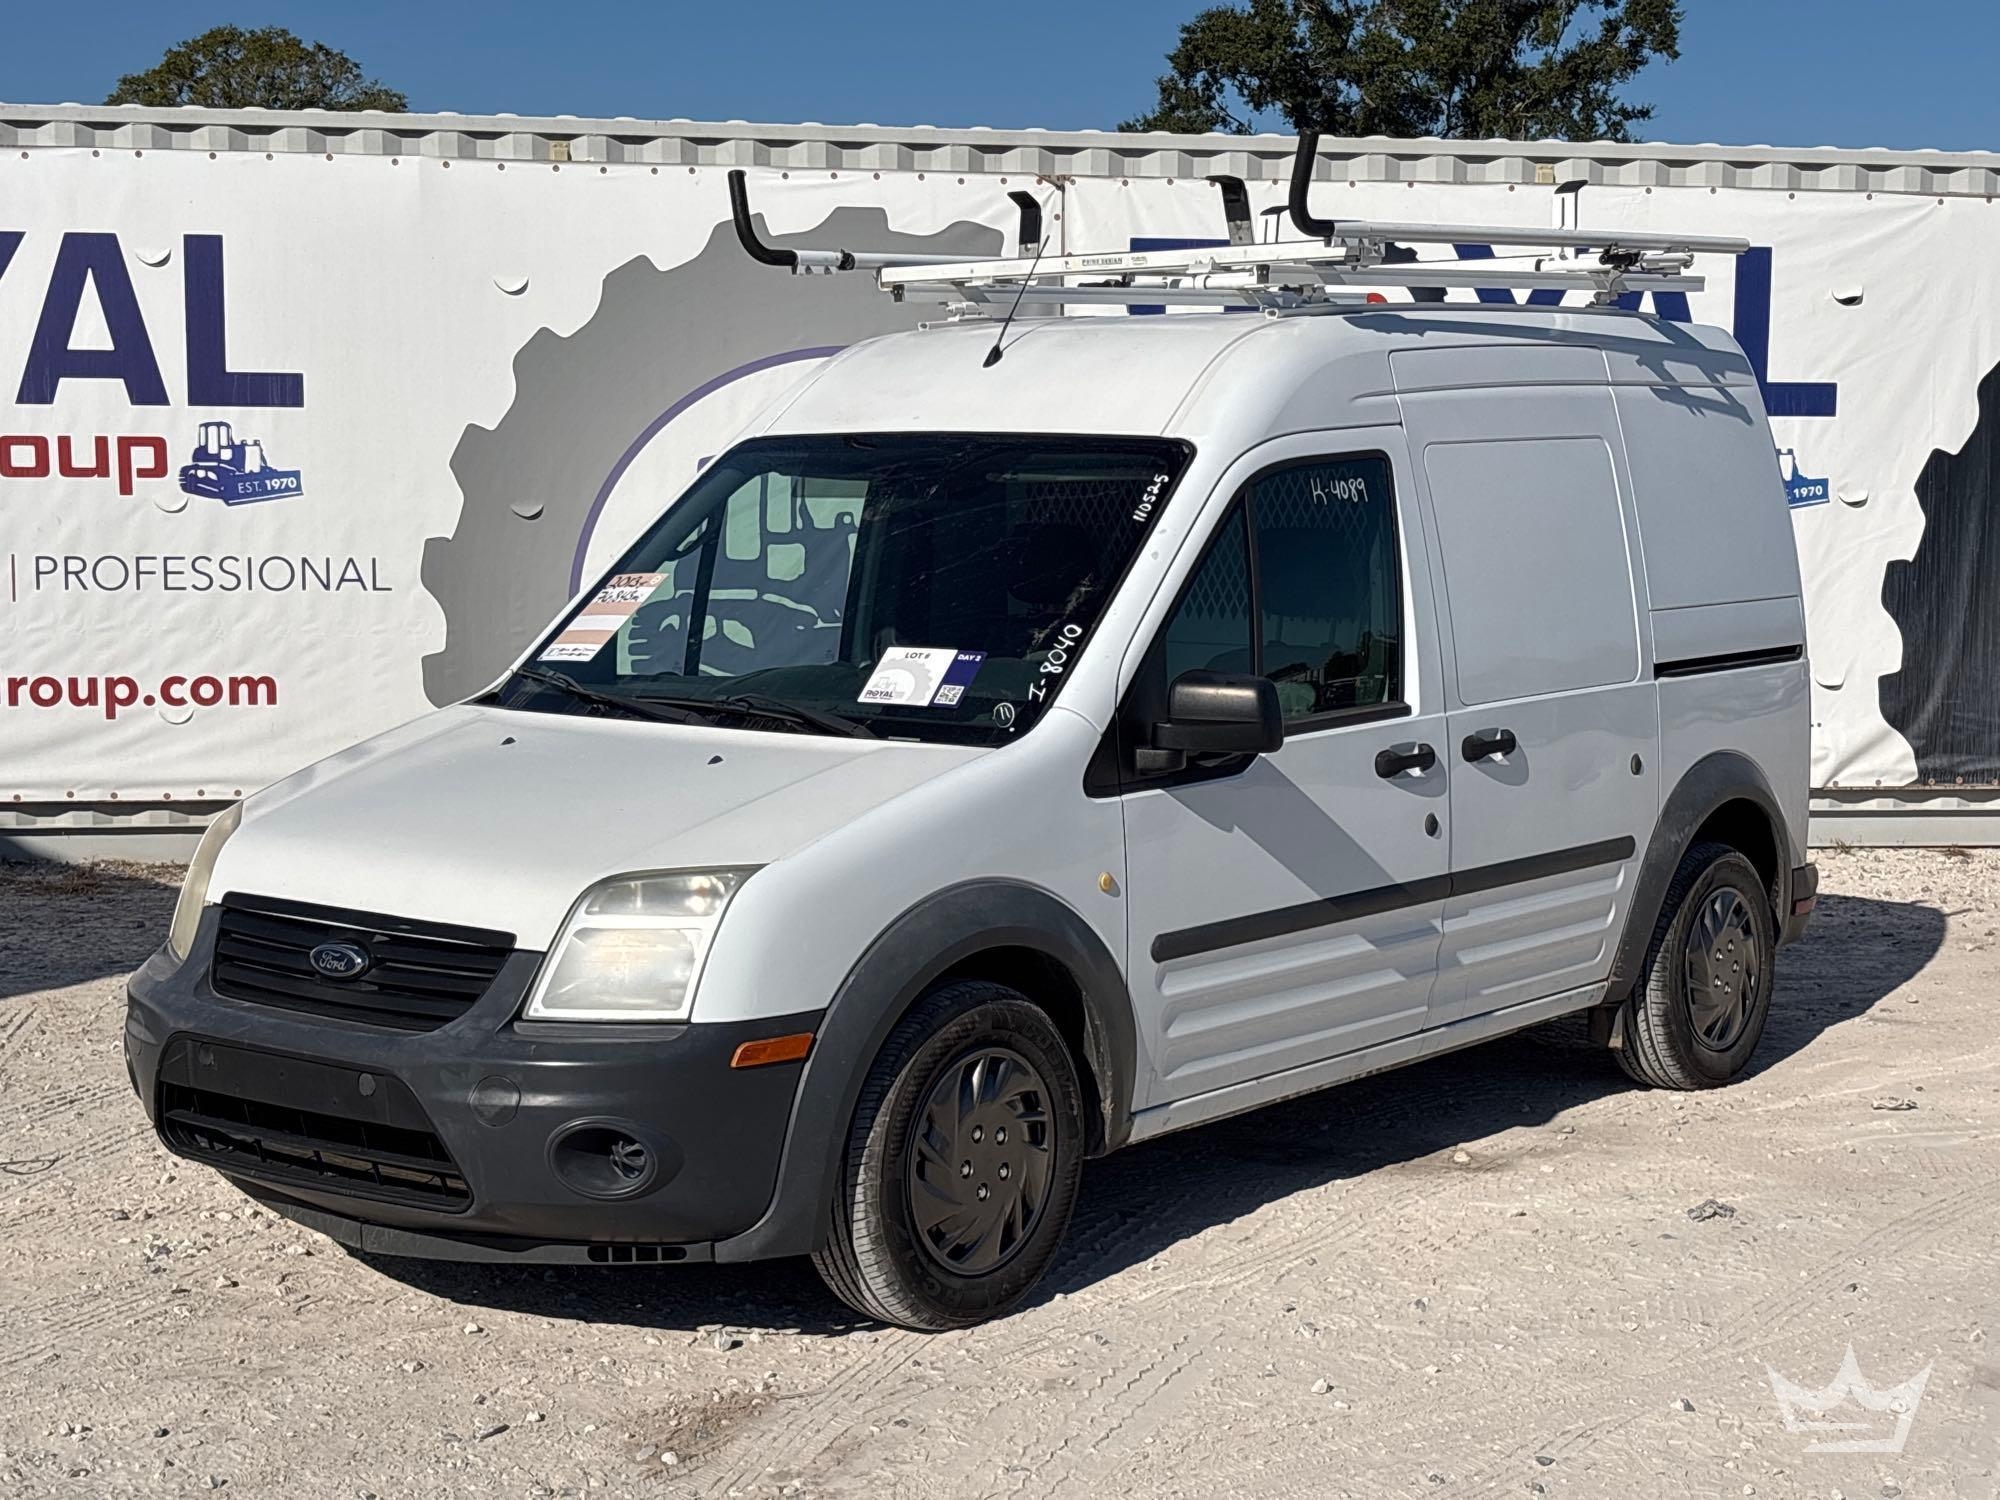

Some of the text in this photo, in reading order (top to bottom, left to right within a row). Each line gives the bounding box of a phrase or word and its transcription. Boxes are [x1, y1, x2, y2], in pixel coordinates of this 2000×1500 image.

[0, 231, 304, 407] AL
[238, 477, 297, 494] EST. 1970
[1793, 485, 1823, 499] 1970
[34, 555, 393, 592] PROFESSIONAL
[905, 652, 932, 660] LOT #
[957, 653, 974, 661] DAY
[0, 675, 278, 720] roup.com
[865, 689, 894, 698] ROYAL
[319, 950, 348, 971] Ford
